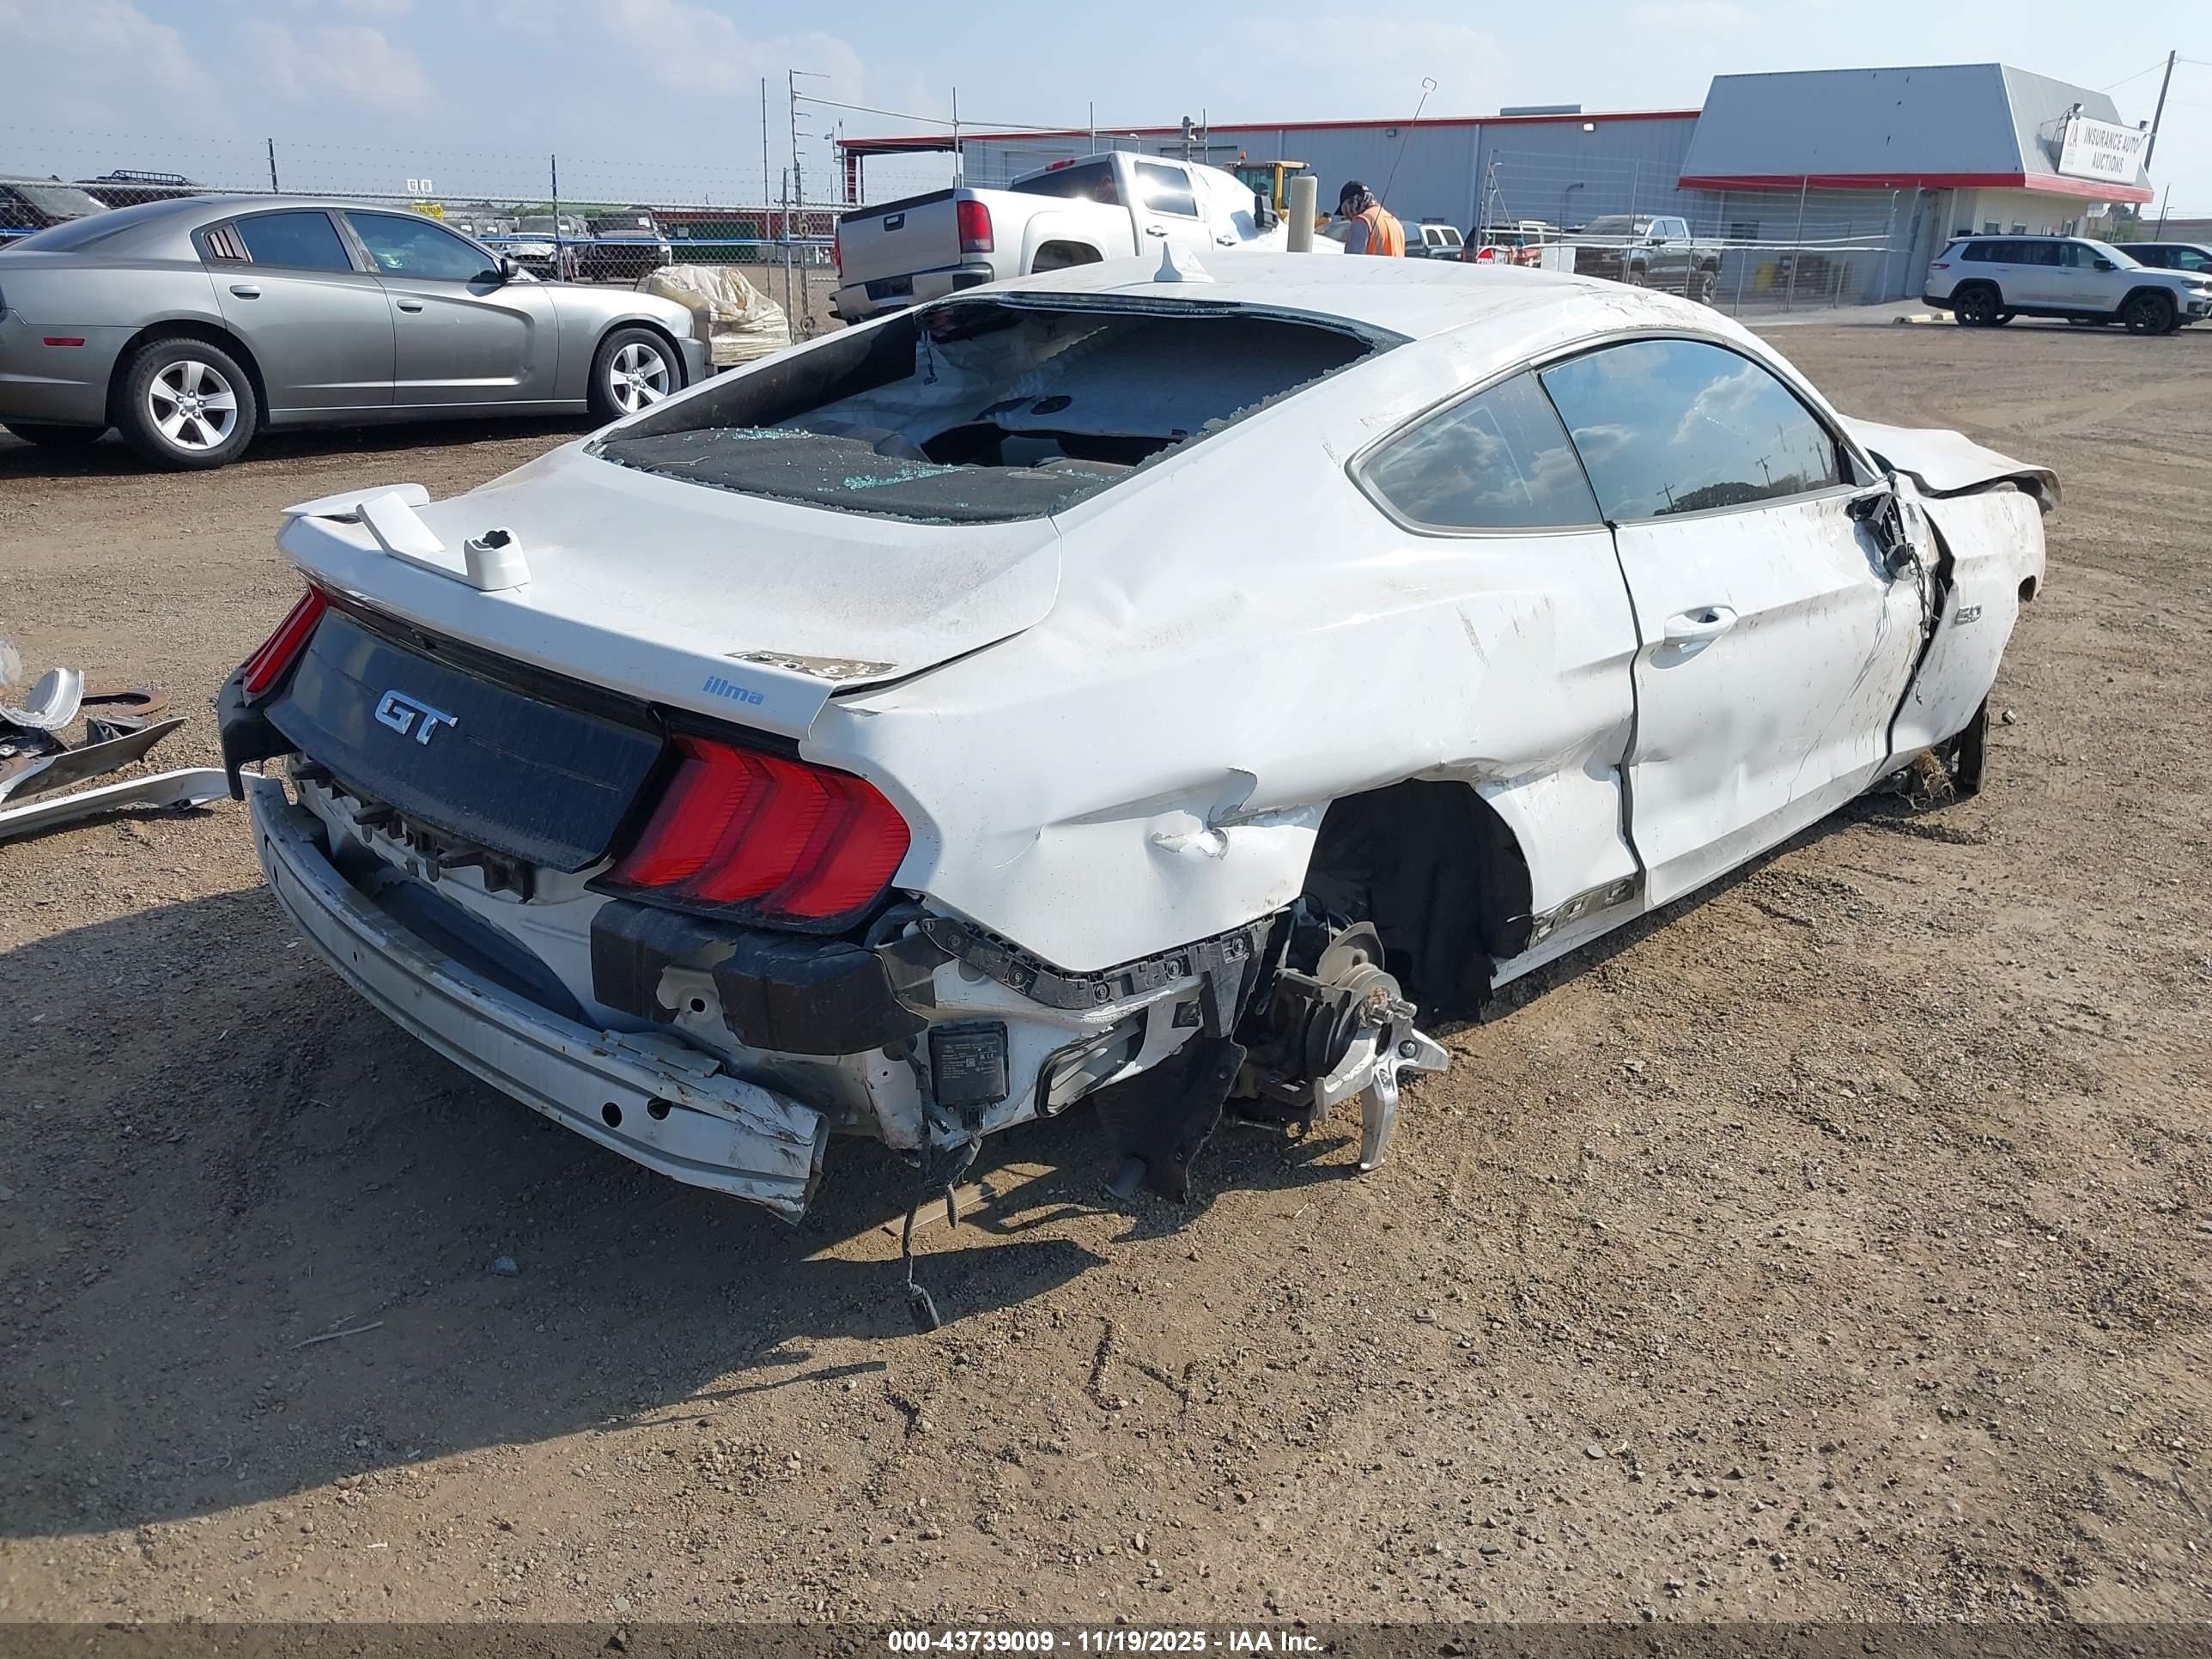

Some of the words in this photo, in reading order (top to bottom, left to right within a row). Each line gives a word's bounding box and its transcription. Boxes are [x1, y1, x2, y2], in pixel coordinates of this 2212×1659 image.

[2083, 125, 2123, 151] INSURANCE
[2121, 135, 2139, 155] AUTO
[2090, 151, 2124, 173] AUCTIONS
[702, 675, 764, 706] illma
[374, 690, 459, 745] GT
